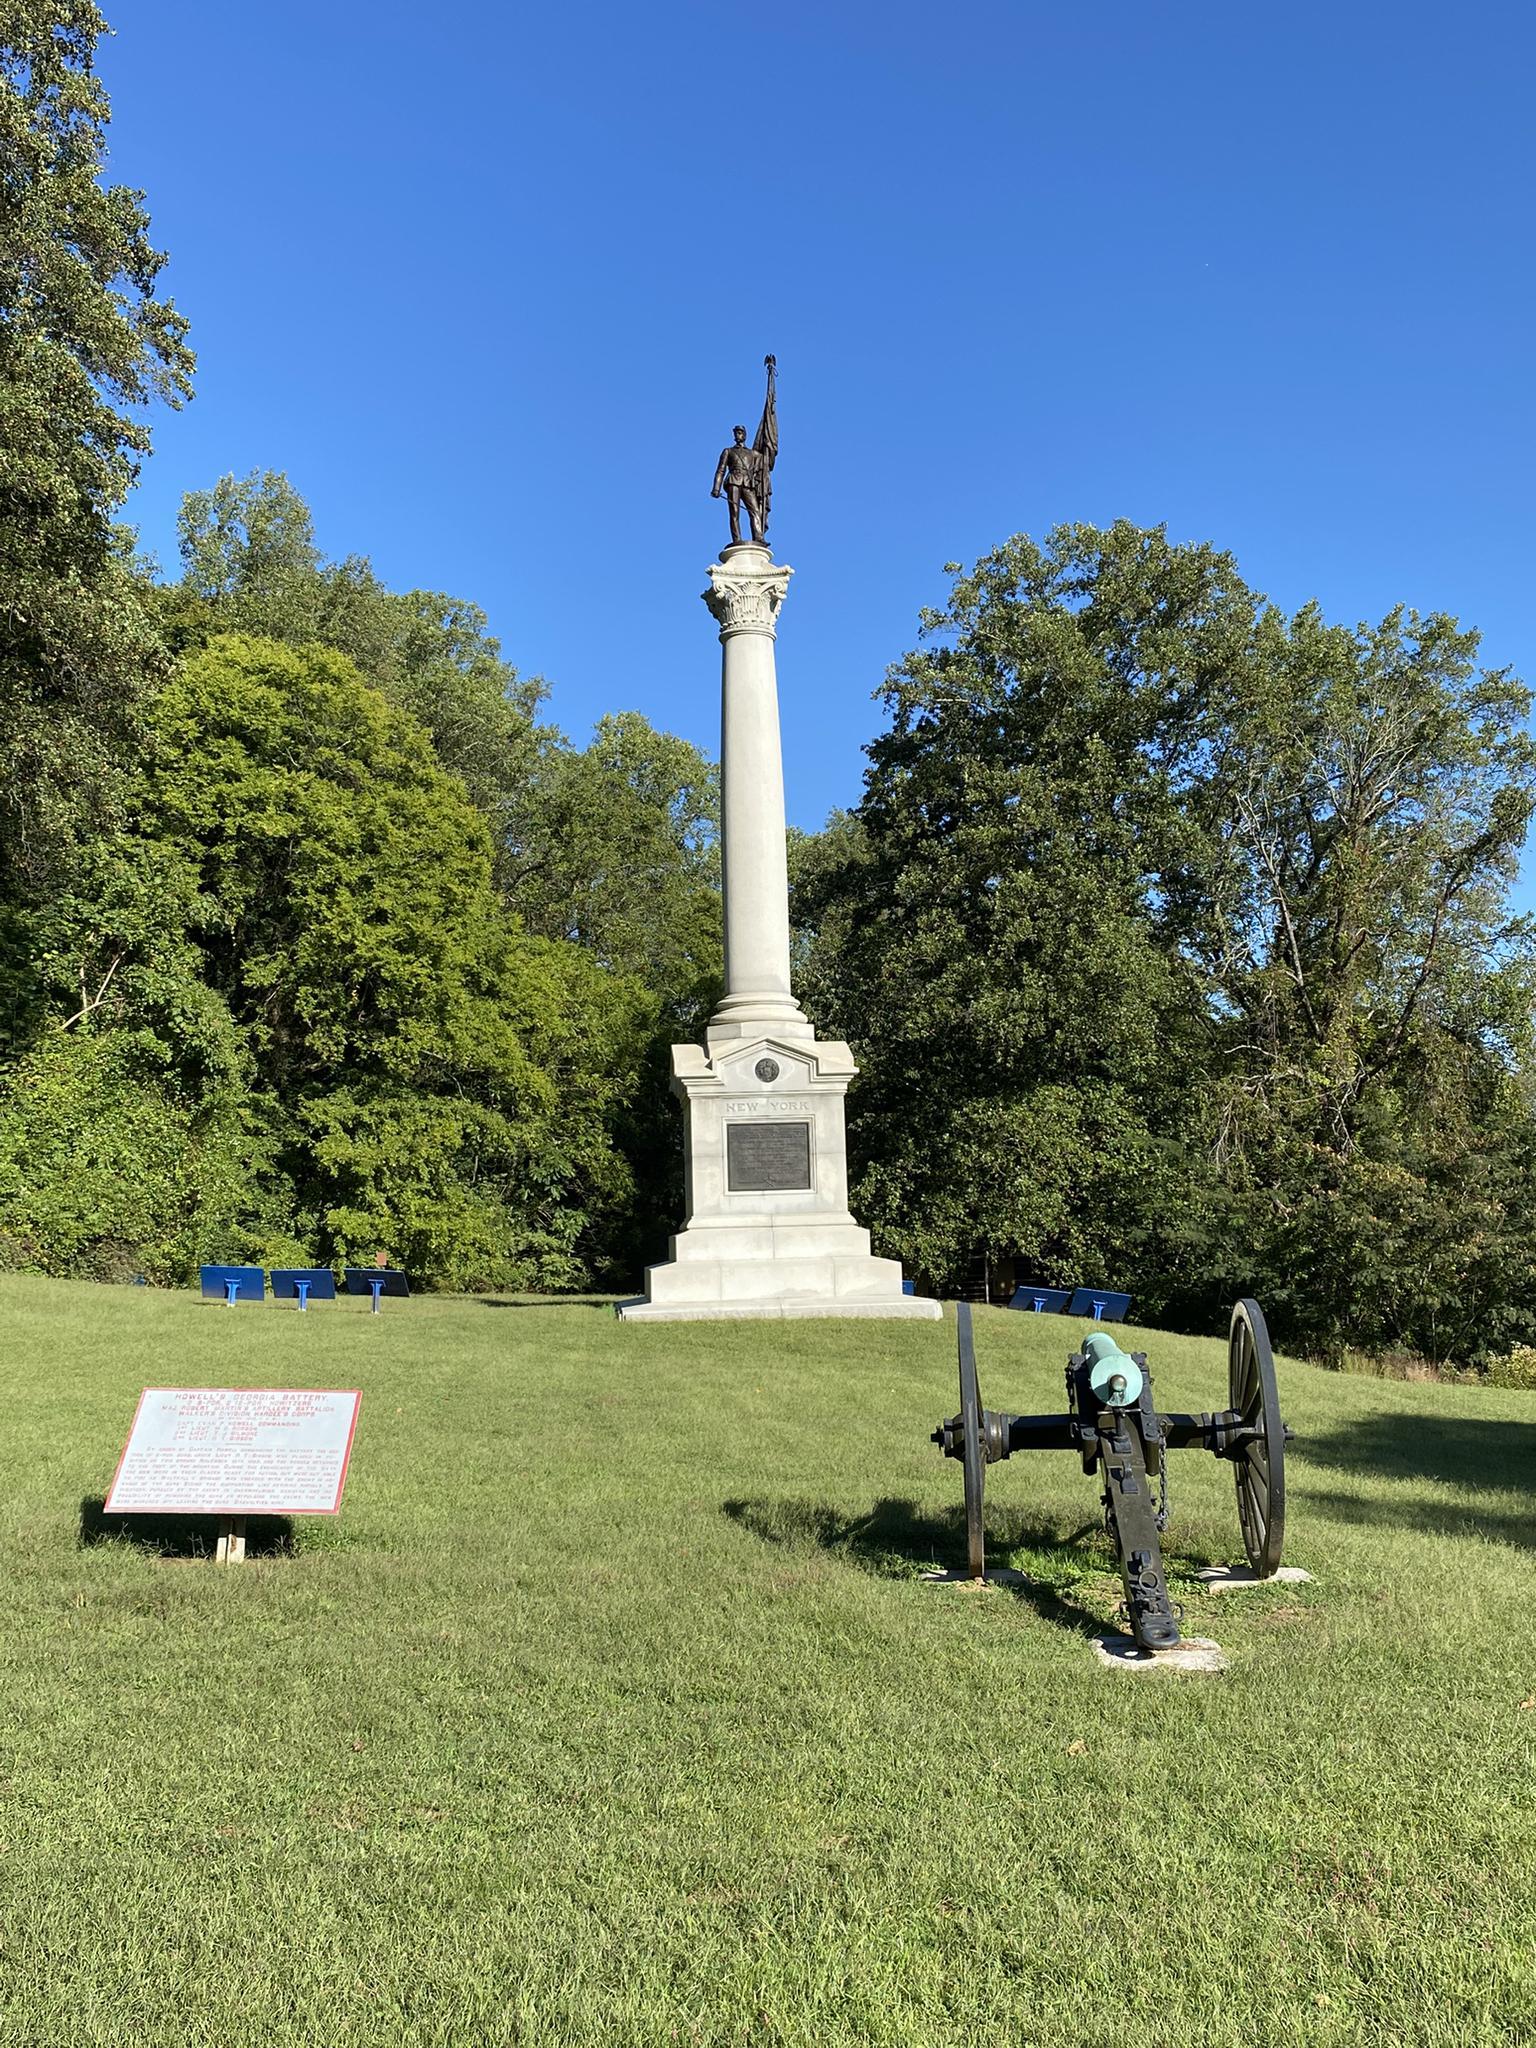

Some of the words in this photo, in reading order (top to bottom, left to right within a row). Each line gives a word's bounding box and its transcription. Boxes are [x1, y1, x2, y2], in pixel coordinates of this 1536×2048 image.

[726, 1102, 758, 1112] NEW
[770, 1101, 809, 1111] YORK
[232, 1393, 275, 1401] GEORGIA
